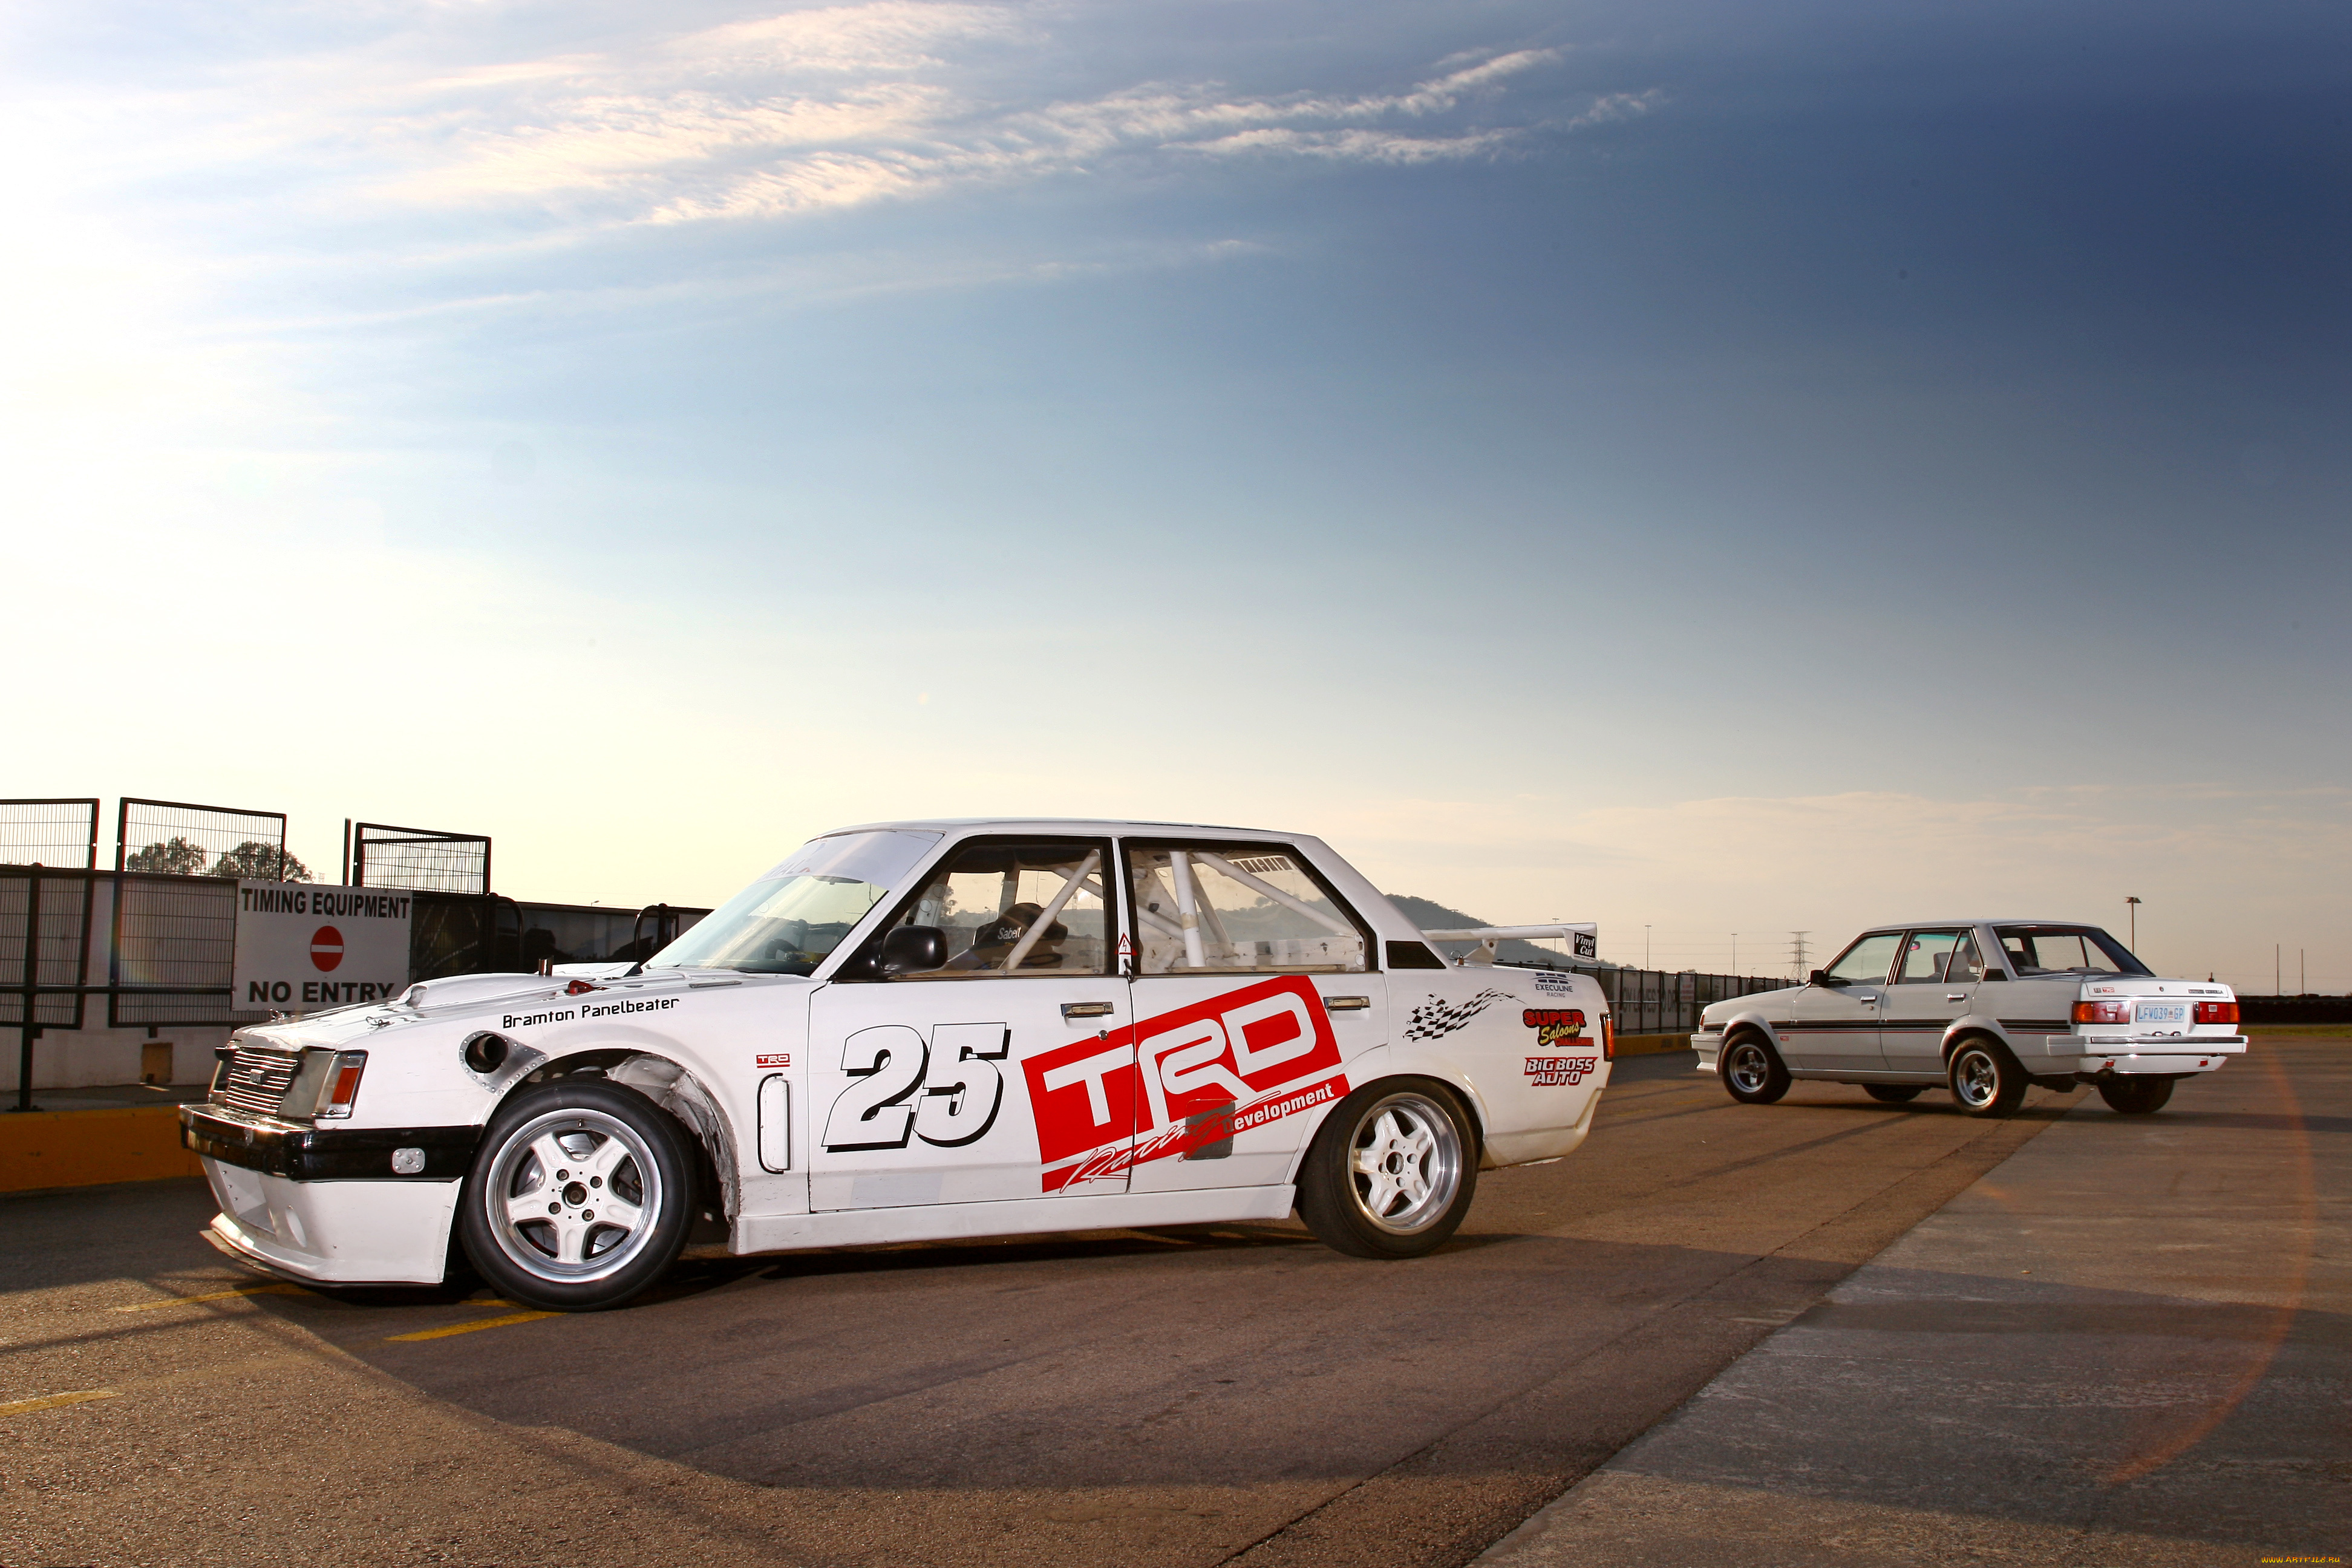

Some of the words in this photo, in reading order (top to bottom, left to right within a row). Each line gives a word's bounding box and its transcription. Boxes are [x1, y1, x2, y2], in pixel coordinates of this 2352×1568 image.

[241, 888, 306, 915] TIMING
[312, 892, 410, 919] EQUIPMENT
[1575, 935, 1595, 949] Vinyl
[1579, 945, 1593, 956] Cut
[249, 981, 292, 1002] NO
[303, 982, 394, 1002] ENTRY
[1535, 984, 1573, 993] EXECULINE
[502, 1010, 574, 1028] Bramton
[581, 998, 680, 1018] Panelbeater
[1524, 1011, 1586, 1025] SUPER
[2174, 1007, 2183, 1019] GP
[1540, 1022, 1579, 1044] Saloons
[757, 1055, 789, 1063] TRD
[1042, 991, 1317, 1129] TRD
[1556, 1058, 1594, 1071] BOSS
[1534, 1071, 1580, 1083] AUTO
[821, 1022, 1011, 1153] 25
[1222, 1083, 1334, 1134] Development
